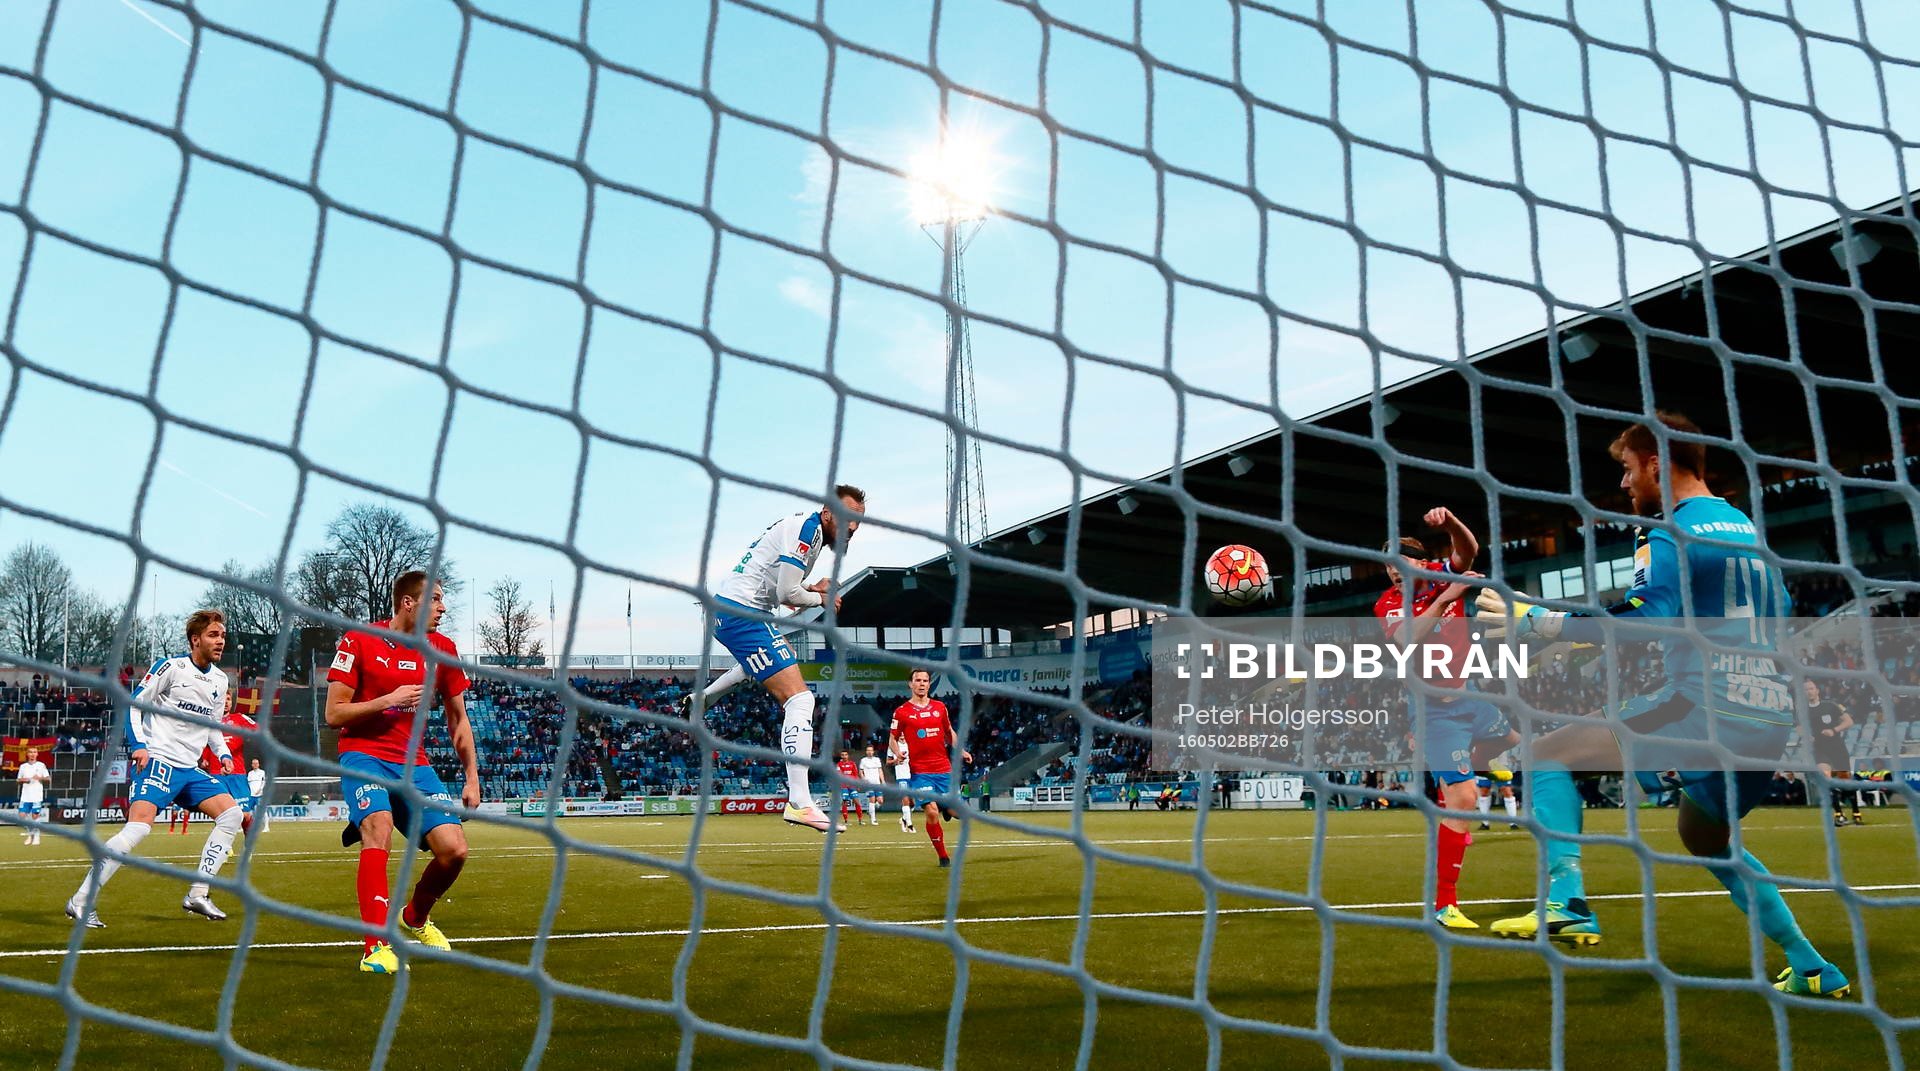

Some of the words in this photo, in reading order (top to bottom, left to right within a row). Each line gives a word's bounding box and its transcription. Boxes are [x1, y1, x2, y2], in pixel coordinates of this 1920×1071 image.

[777, 648, 791, 661] 10
[140, 785, 149, 795] 5
[1243, 780, 1294, 800] POUR
[651, 802, 678, 812] SEB
[690, 802, 716, 812] SB
[63, 808, 125, 819] OPTERA
